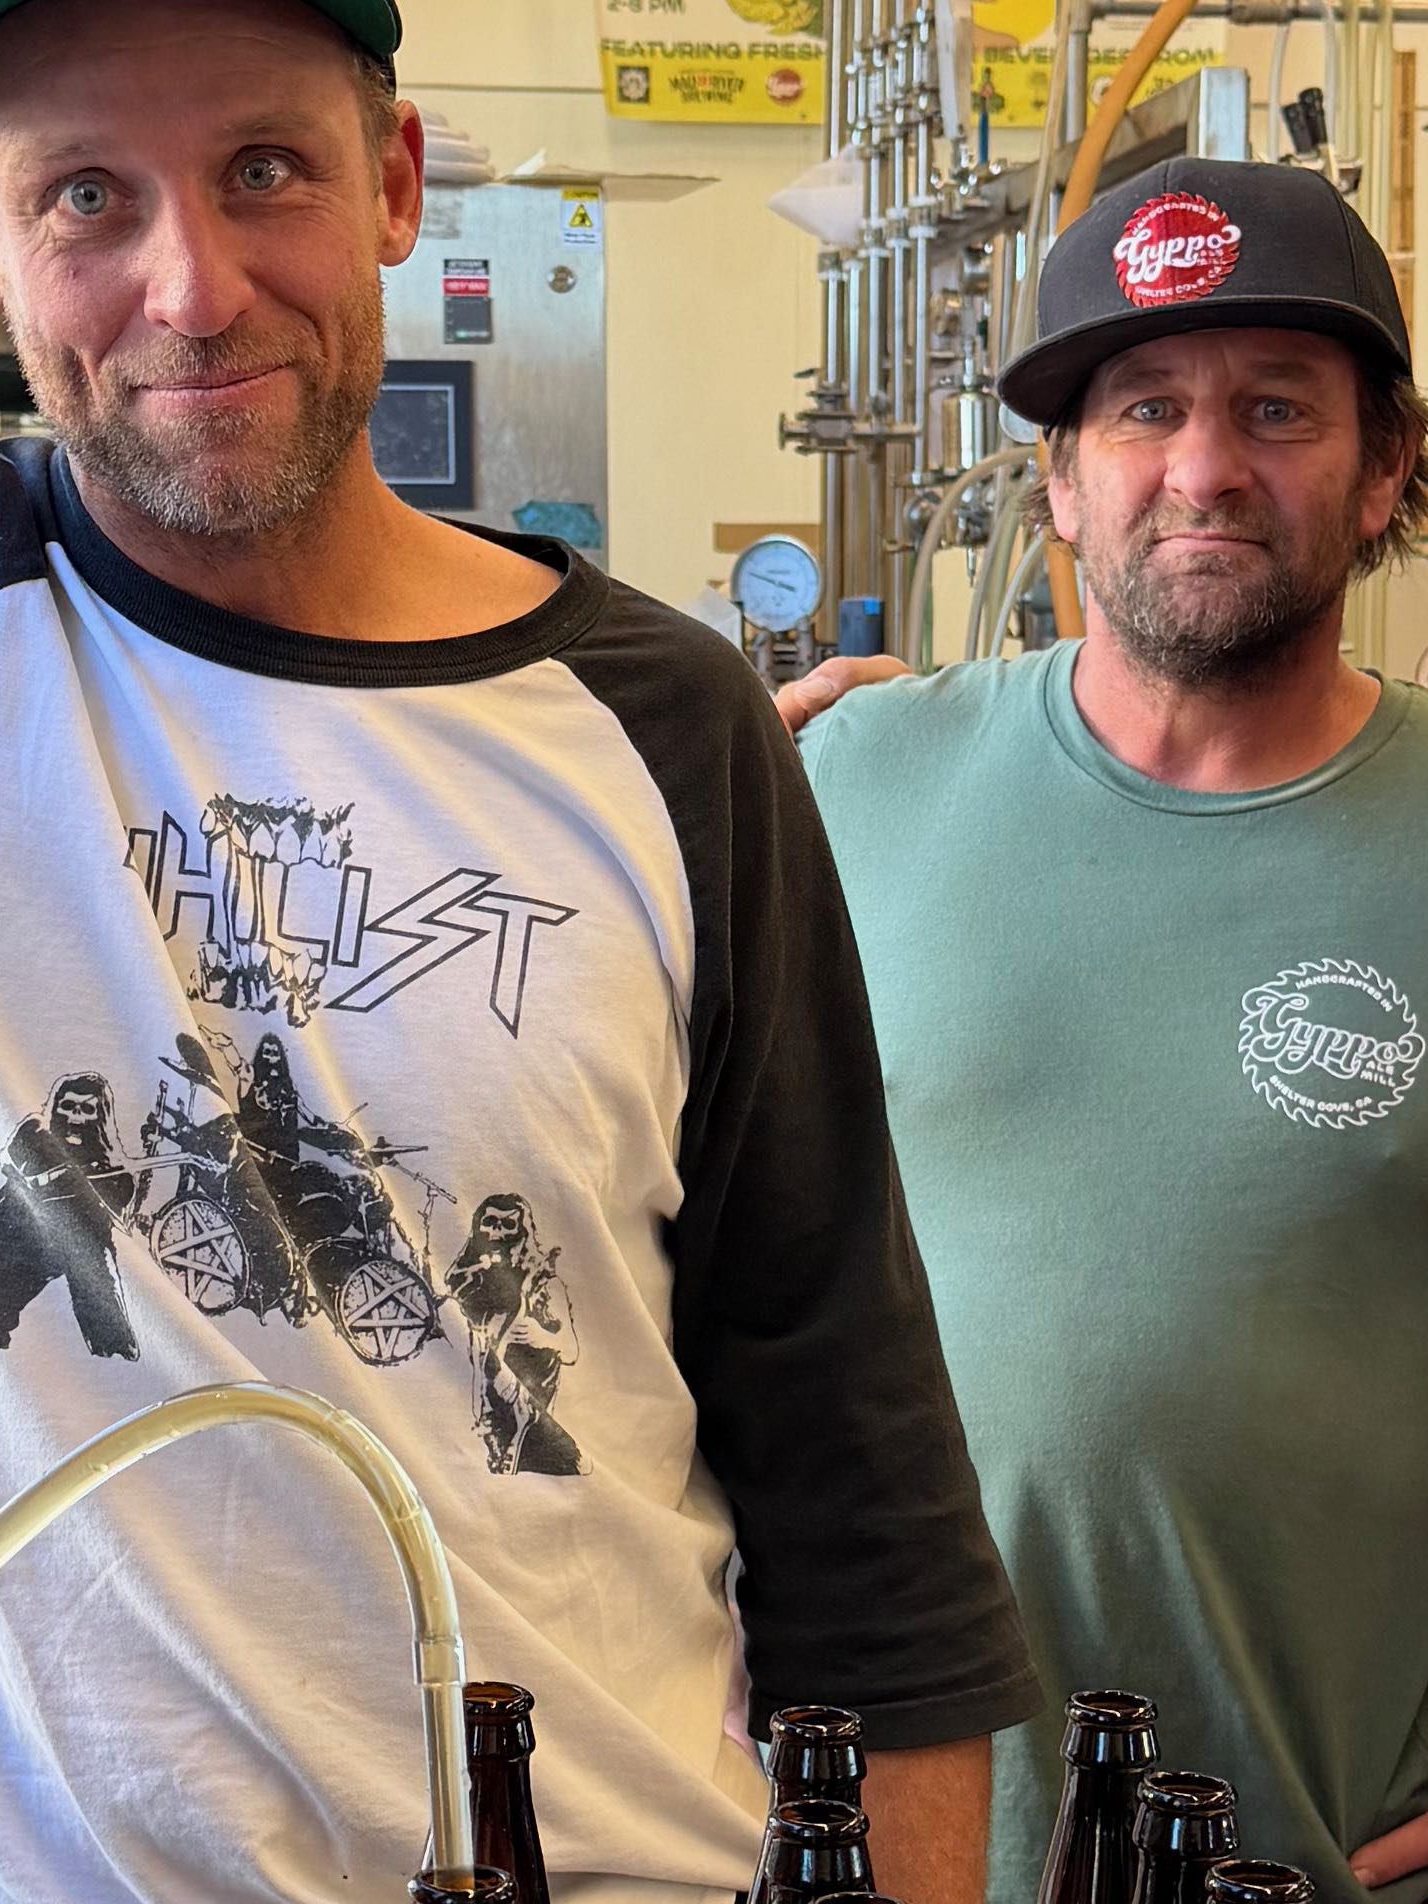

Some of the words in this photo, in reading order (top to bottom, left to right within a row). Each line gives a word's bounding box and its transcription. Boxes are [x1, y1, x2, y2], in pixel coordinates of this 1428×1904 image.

[601, 39, 742, 60] FEATURING
[1113, 224, 1242, 284] Gyppo
[1295, 974, 1383, 1001] HANDCRAFTED
[1380, 998, 1394, 1013] IN
[1242, 987, 1426, 1080] Gyppo
[1360, 1070, 1397, 1088] MILL
[1365, 1060, 1395, 1074] ALE
[1269, 1074, 1315, 1109] SHELTER
[1355, 1096, 1373, 1109] CA
